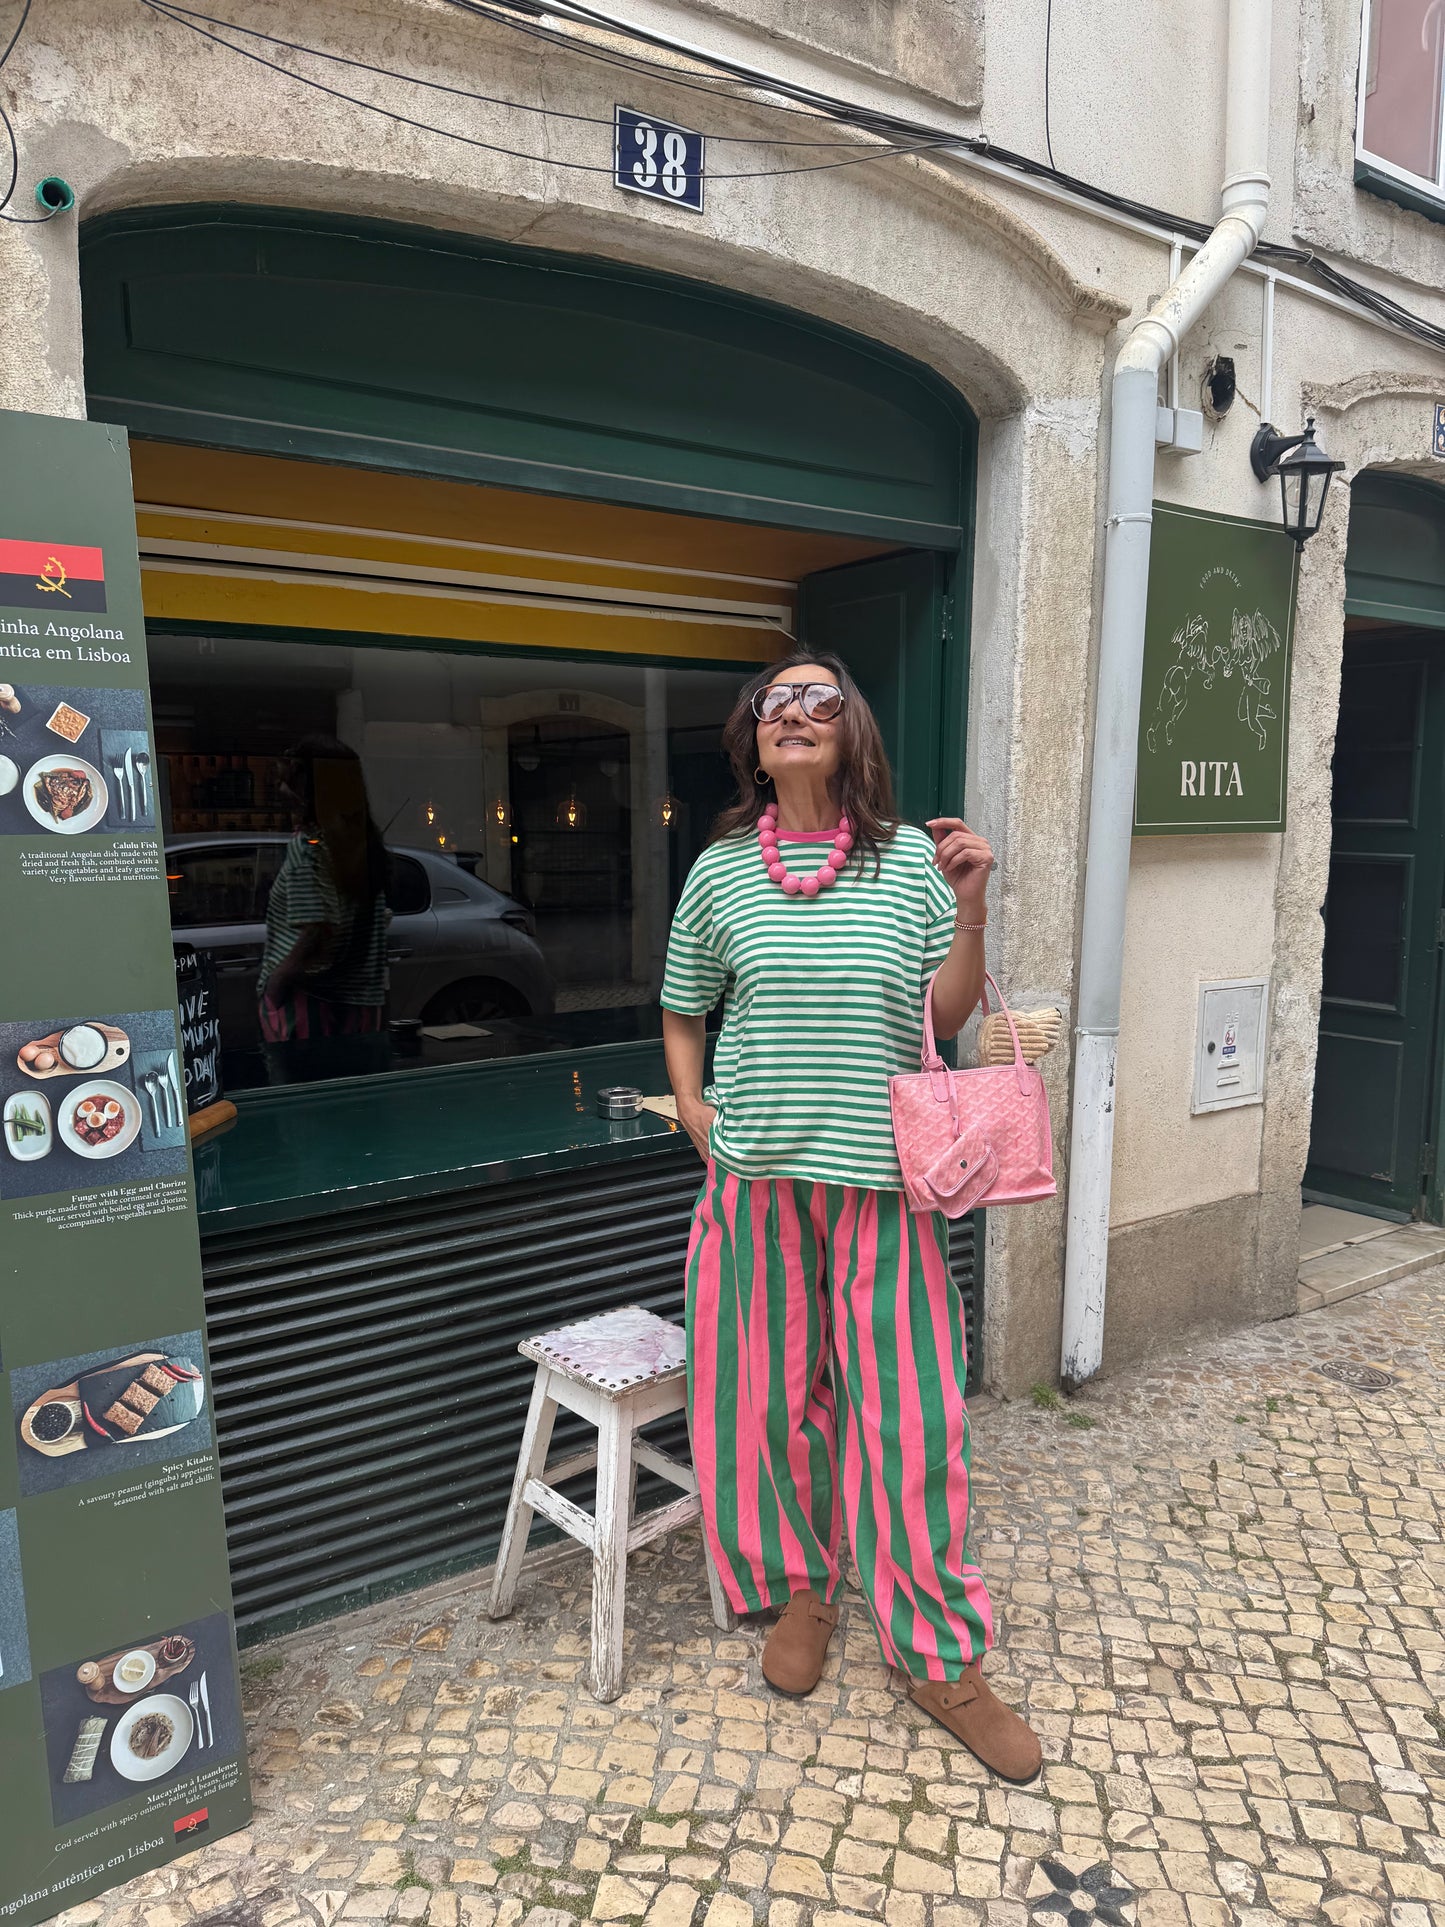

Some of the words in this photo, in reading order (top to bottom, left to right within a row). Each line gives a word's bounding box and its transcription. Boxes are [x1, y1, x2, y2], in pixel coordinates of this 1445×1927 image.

[633, 122, 687, 197] 38
[1200, 570, 1211, 588] FOOD
[1213, 566, 1224, 574] AND
[1225, 568, 1242, 588] DRINK
[0, 619, 40, 635] inha
[44, 622, 124, 642] Angolana
[46, 648, 72, 660] em
[77, 647, 131, 663] Lisboa
[1180, 761, 1244, 796] RITA
[71, 851, 101, 860] Angolan
[50, 876, 67, 884] Very
[60, 867, 98, 875] vegetables
[116, 866, 133, 874] leafy
[135, 867, 159, 875] greens.
[71, 1194, 97, 1204] Funge
[100, 1189, 118, 1197] with
[120, 1188, 136, 1196] Egg
[139, 1184, 153, 1193] and
[156, 1180, 186, 1189] Chorizo
[13, 1211, 34, 1220] Thick
[36, 1208, 56, 1218] purée
[58, 1205, 78, 1213] made
[120, 1193, 151, 1203] cornmeal
[58, 1217, 105, 1229] accompanied
[117, 1210, 151, 1220] vegetables
[153, 1206, 165, 1214] and
[67, 1210, 90, 1220] served
[92, 1208, 108, 1216] with
[110, 1204, 131, 1213] boiled
[132, 1203, 146, 1212] egg
[146, 1199, 159, 1207] and
[161, 1197, 187, 1206] chorizo,
[162, 1463, 184, 1474] Spicy
[187, 1456, 213, 1466] Kitaba
[87, 1492, 115, 1504] savoury
[118, 1484, 144, 1497] peanut
[145, 1474, 179, 1489] (ginguba)
[114, 1492, 146, 1506] seasoned
[148, 1487, 164, 1496] with
[181, 1479, 193, 1488] and
[147, 1783, 189, 1804] Macayabo
[197, 1762, 238, 1783] Luandense
[204, 1785, 216, 1796] and
[218, 1778, 239, 1790] funge.
[55, 1839, 71, 1851] Cod
[74, 1828, 98, 1844] served
[101, 1821, 117, 1832] with
[120, 1813, 138, 1825] spicy
[140, 1801, 167, 1815] onions,
[169, 1792, 187, 1805] palm
[0, 1888, 49, 1915] ngolana
[52, 1863, 105, 1893] autêntica
[107, 1854, 125, 1867] em
[128, 1836, 165, 1859] Lisboa
